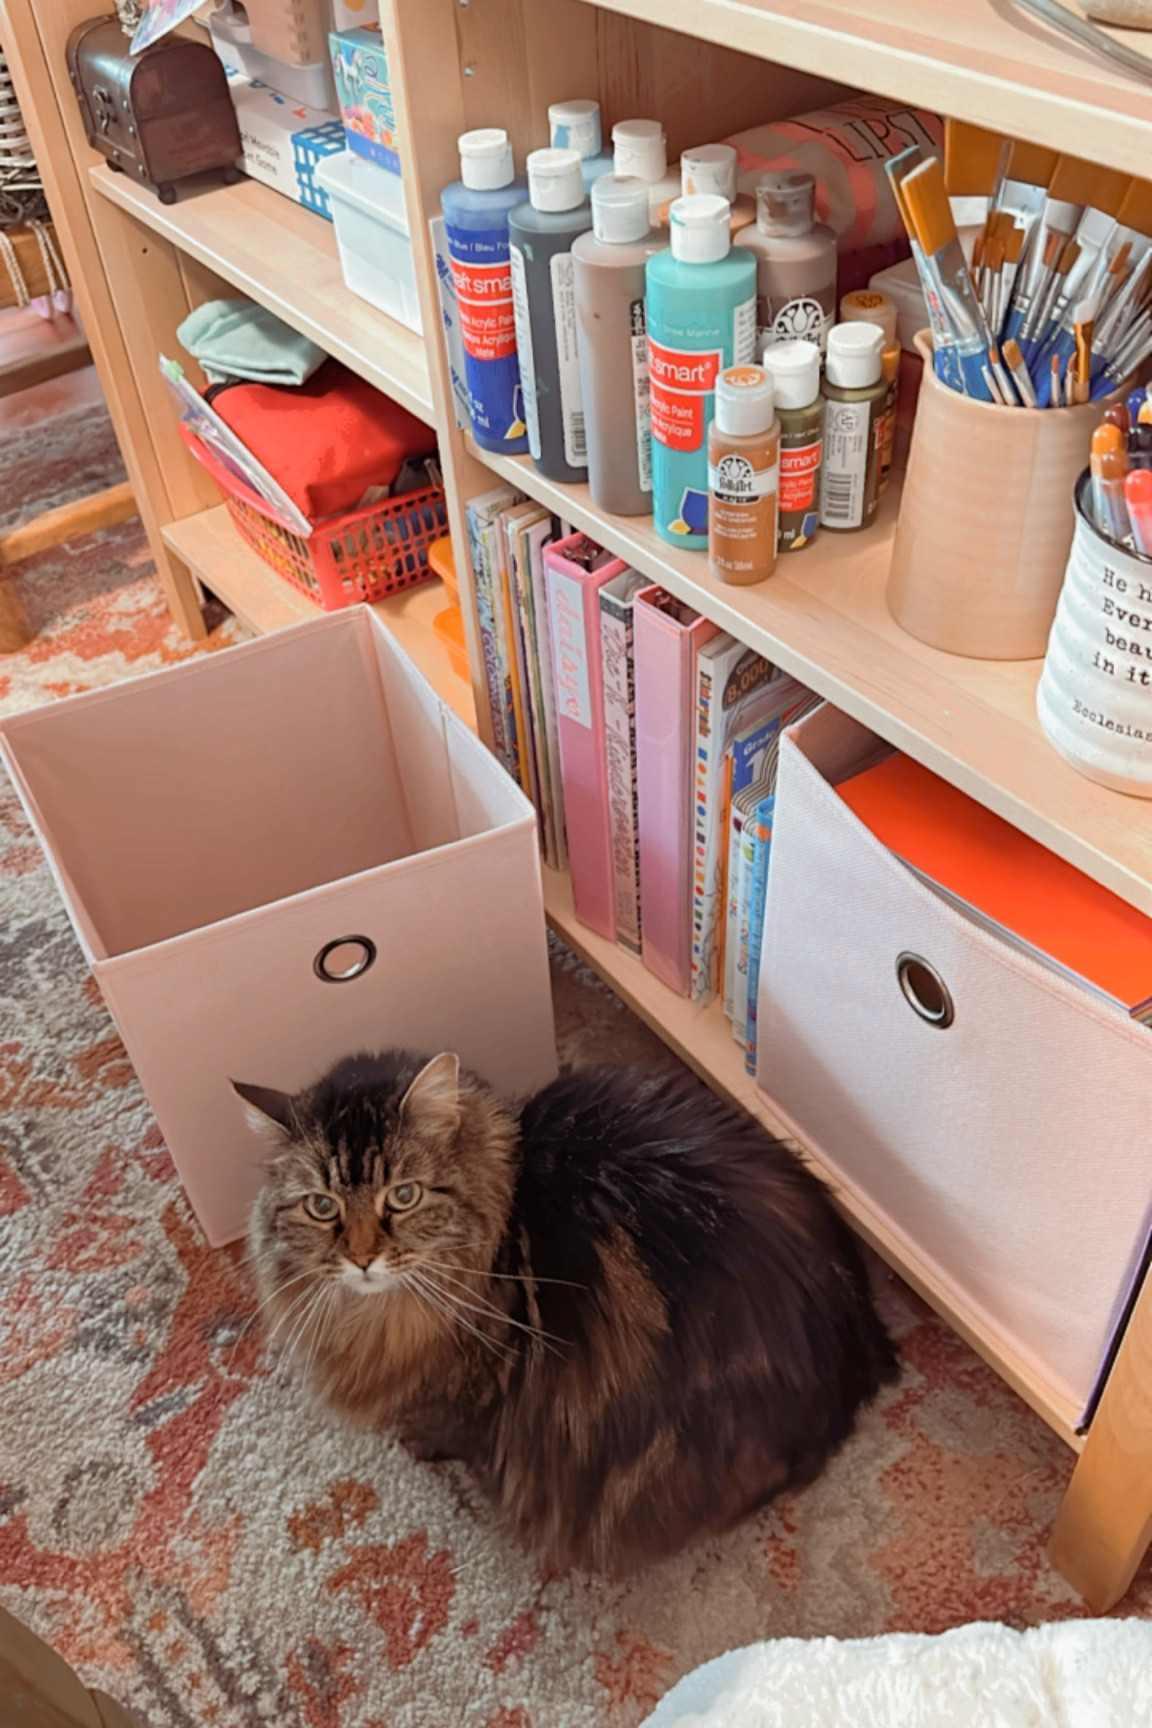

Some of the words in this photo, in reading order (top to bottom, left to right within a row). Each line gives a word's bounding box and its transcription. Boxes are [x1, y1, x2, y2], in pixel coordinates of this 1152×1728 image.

[1102, 566, 1128, 593] He
[1101, 597, 1152, 632] Ever
[1092, 651, 1115, 675] in
[1126, 666, 1150, 687] it
